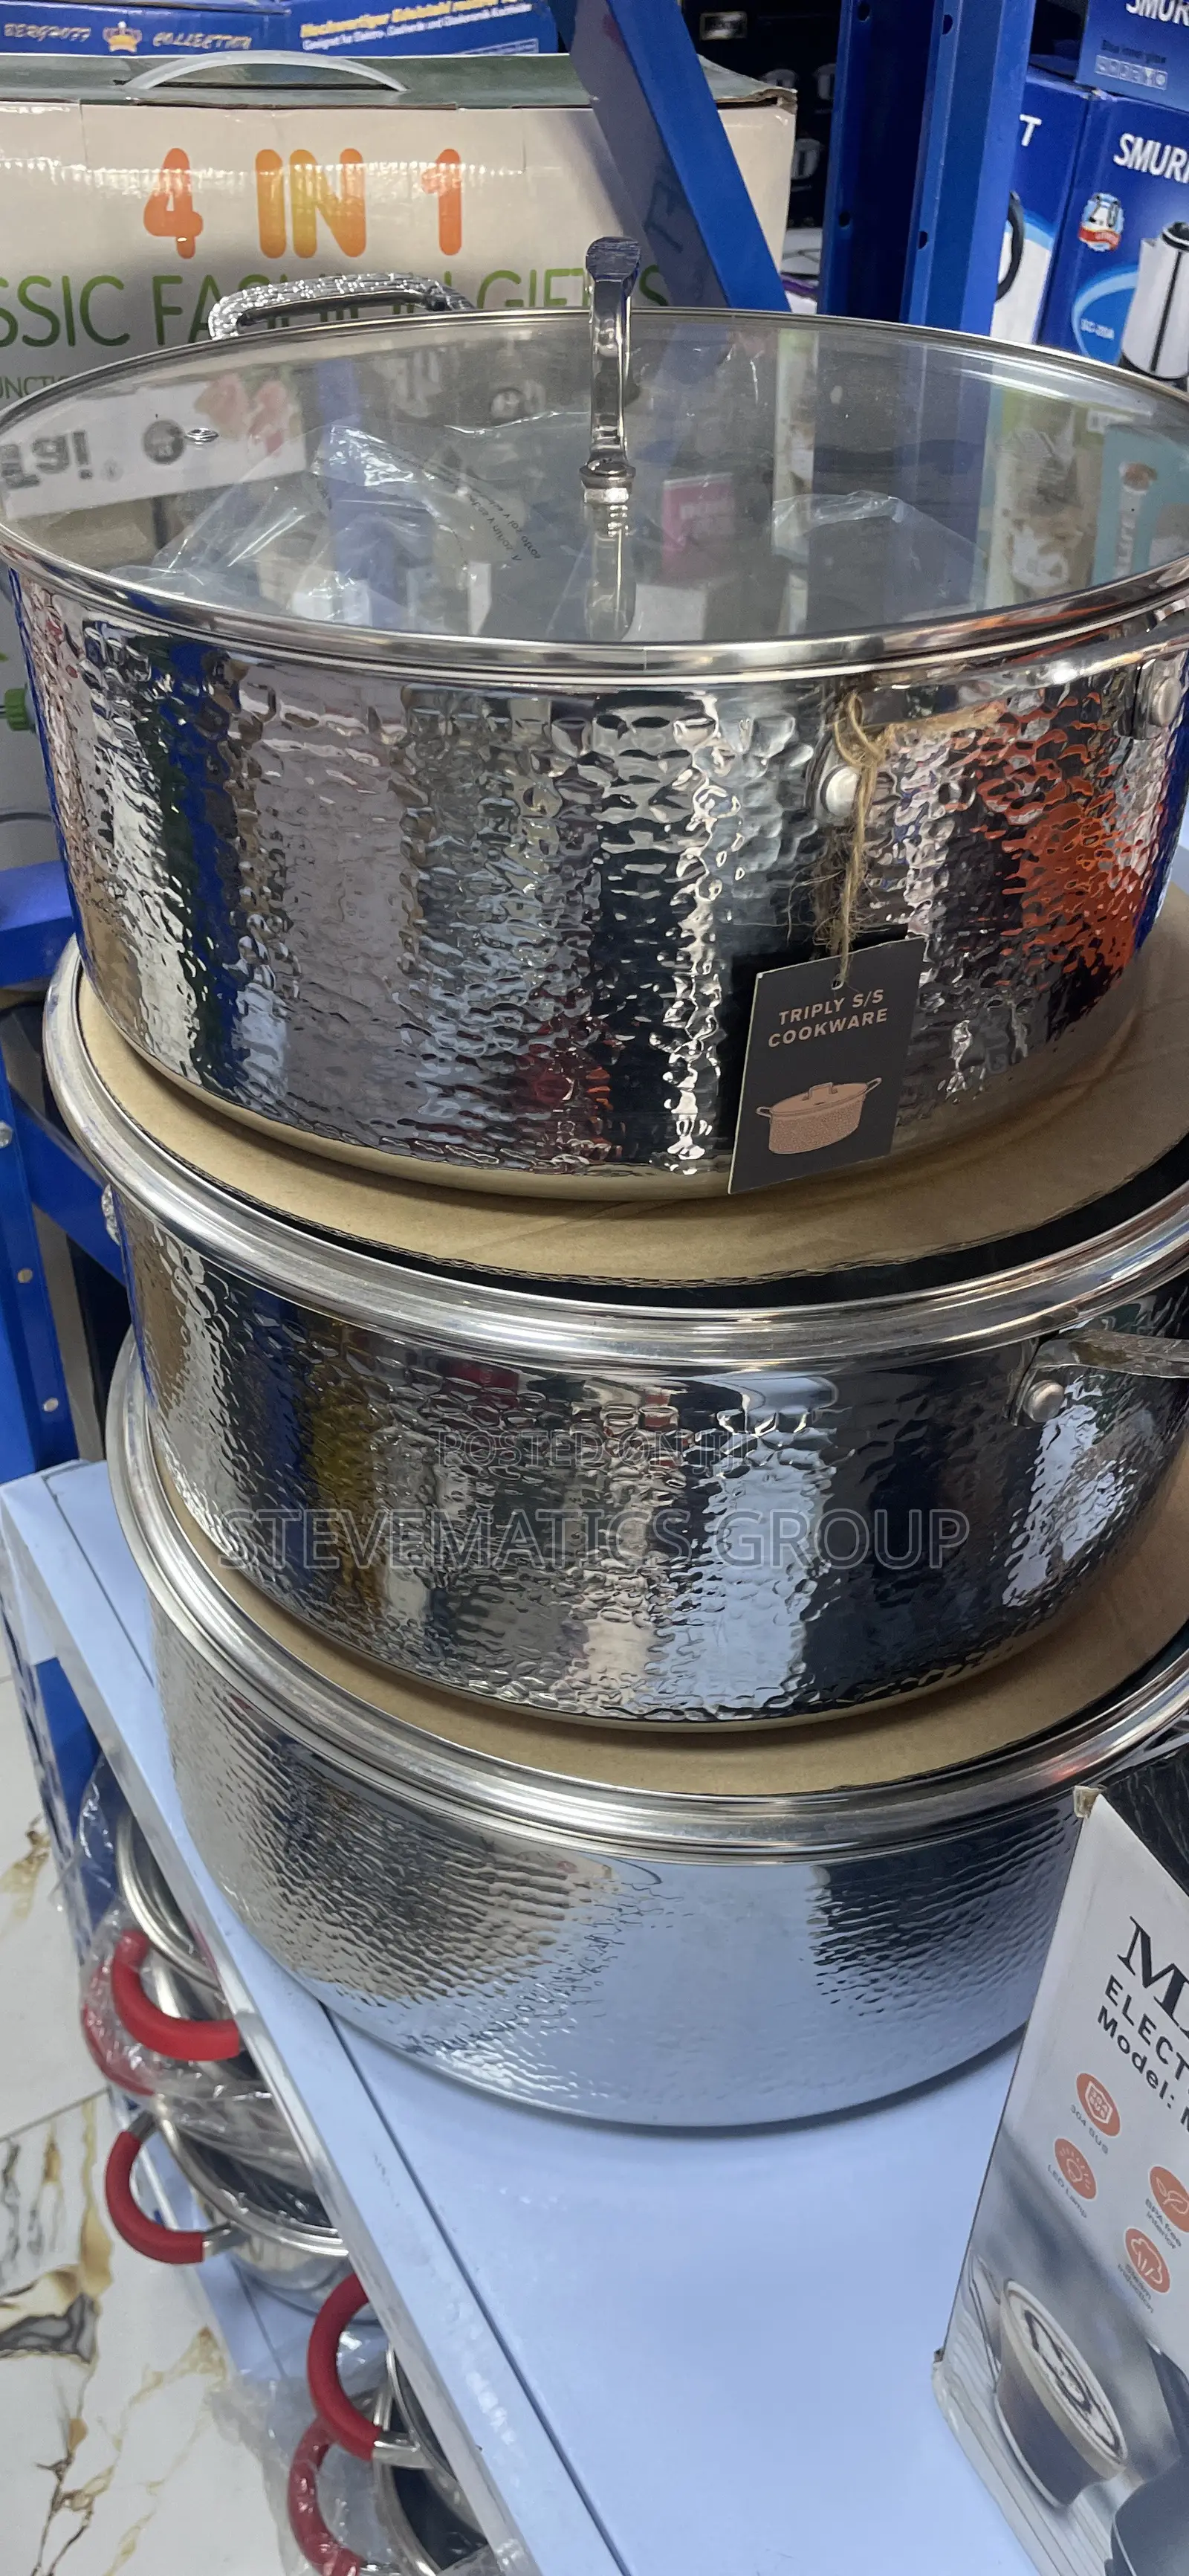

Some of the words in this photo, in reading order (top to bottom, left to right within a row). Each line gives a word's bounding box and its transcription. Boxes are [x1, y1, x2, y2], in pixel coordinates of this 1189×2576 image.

[143, 148, 203, 259] 4
[256, 149, 366, 259] IN
[421, 149, 462, 256] 1
[768, 1008, 889, 1048] COOKWARE
[779, 996, 846, 1026] TRIPLY
[852, 989, 884, 1009] S/S
[1097, 2005, 1175, 2110] Model:
